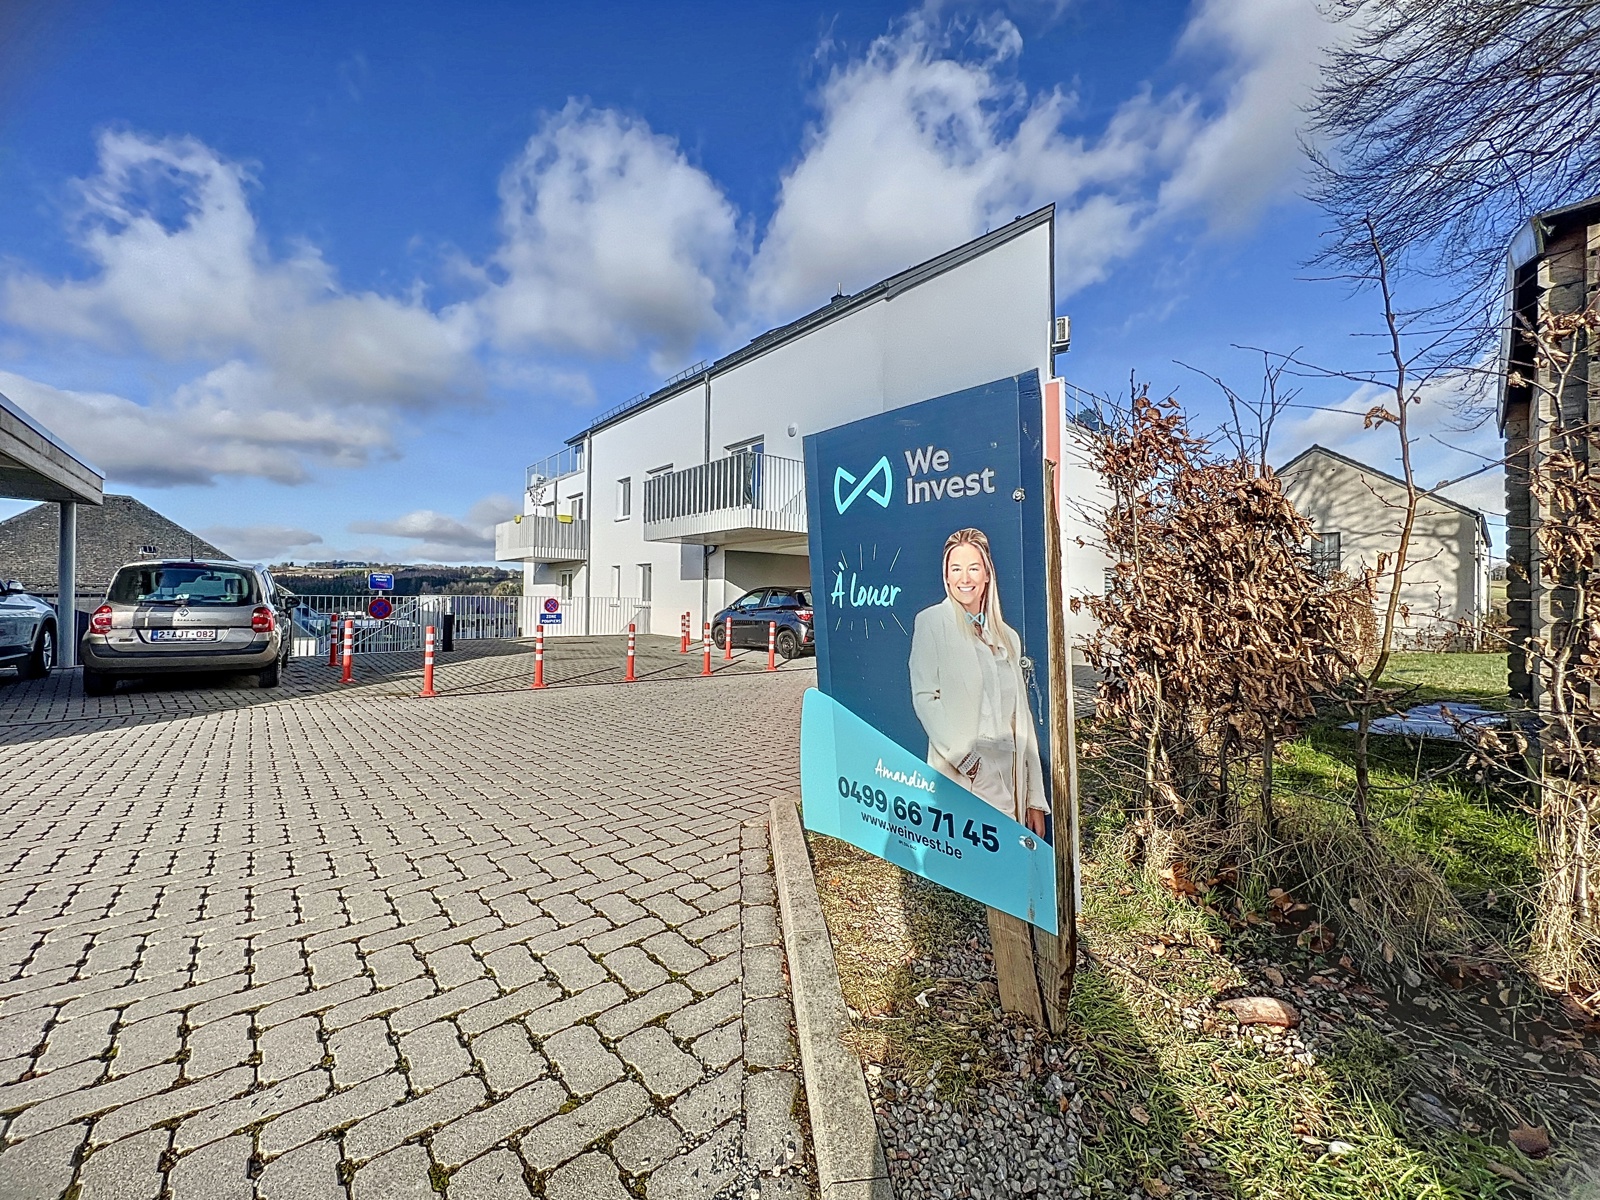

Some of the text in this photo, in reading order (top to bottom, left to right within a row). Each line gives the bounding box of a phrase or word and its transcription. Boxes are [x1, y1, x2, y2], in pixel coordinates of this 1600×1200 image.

[904, 445, 950, 477] We
[906, 467, 996, 505] Invest
[874, 758, 936, 794] Amandine
[838, 776, 1000, 853] 0499 66 71 45
[860, 810, 963, 860] www.weinvest.be
